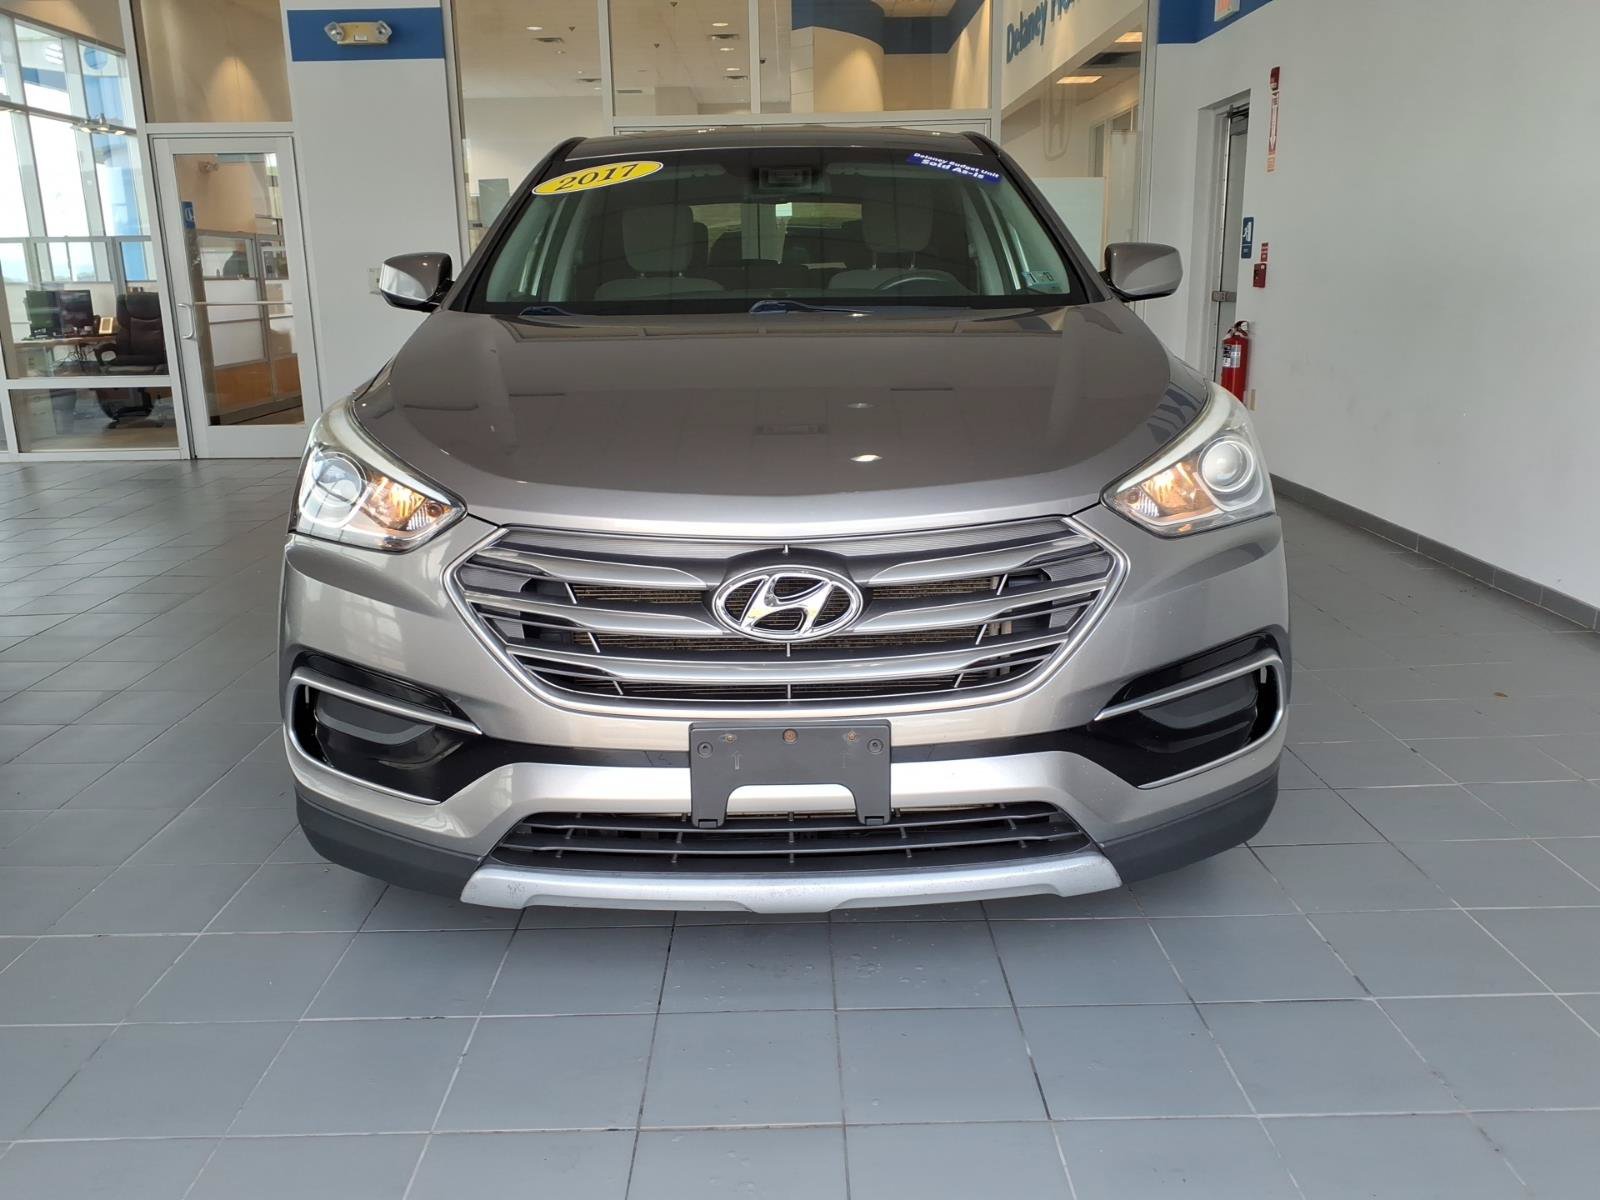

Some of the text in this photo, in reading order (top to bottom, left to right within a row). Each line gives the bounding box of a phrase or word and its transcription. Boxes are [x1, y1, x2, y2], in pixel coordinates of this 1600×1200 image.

[1007, 0, 1048, 64] Delaney
[554, 163, 639, 192] 2017
[913, 152, 999, 178] Delaney Budget Unit
[920, 159, 951, 170] Sold
